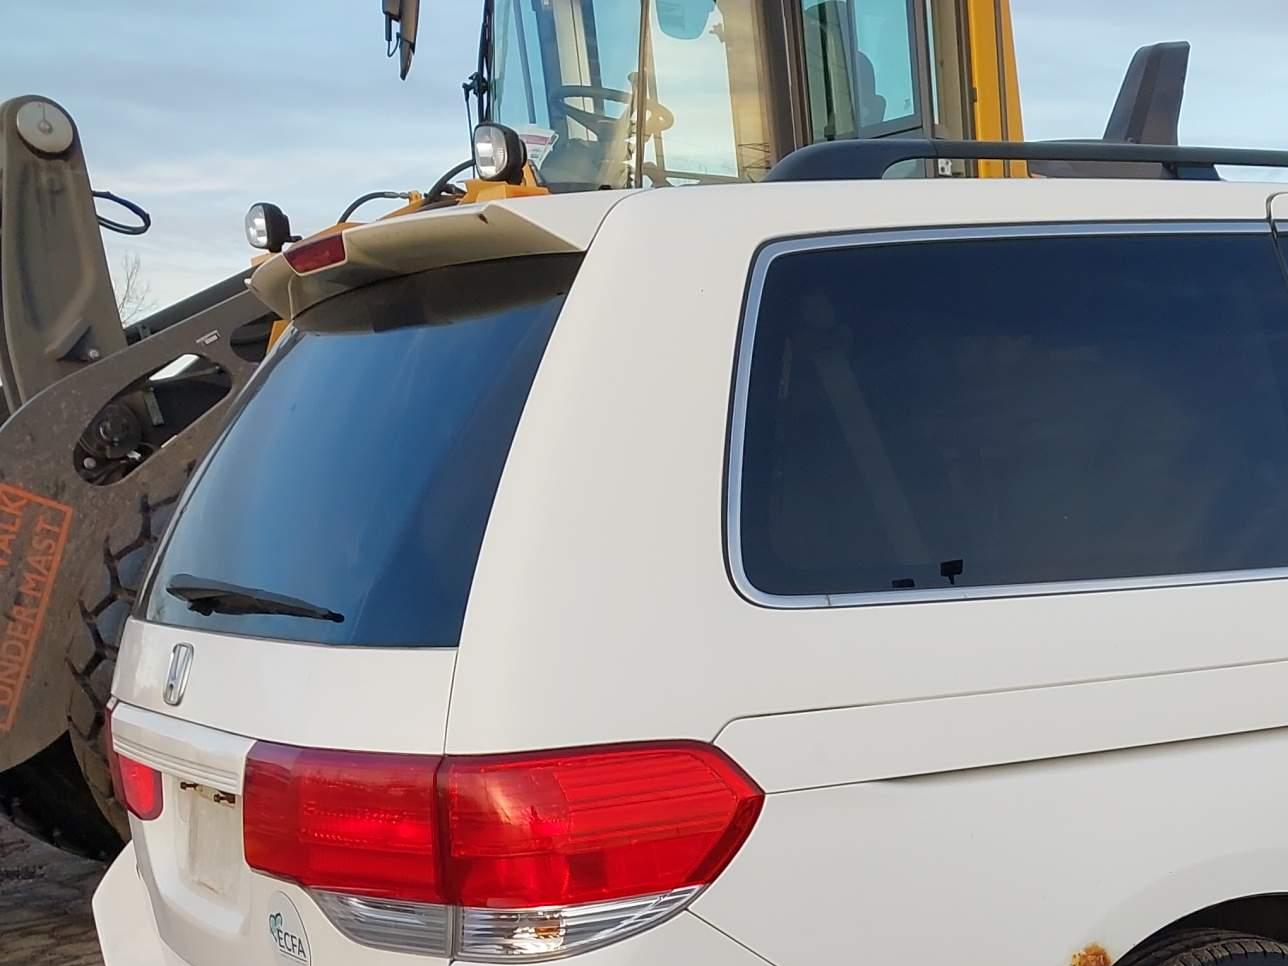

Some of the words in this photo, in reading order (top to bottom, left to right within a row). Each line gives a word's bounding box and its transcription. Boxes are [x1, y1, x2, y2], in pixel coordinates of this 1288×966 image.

[0, 492, 26, 567] ALK
[20, 513, 60, 597] MAST
[277, 929, 307, 958] ECFA
